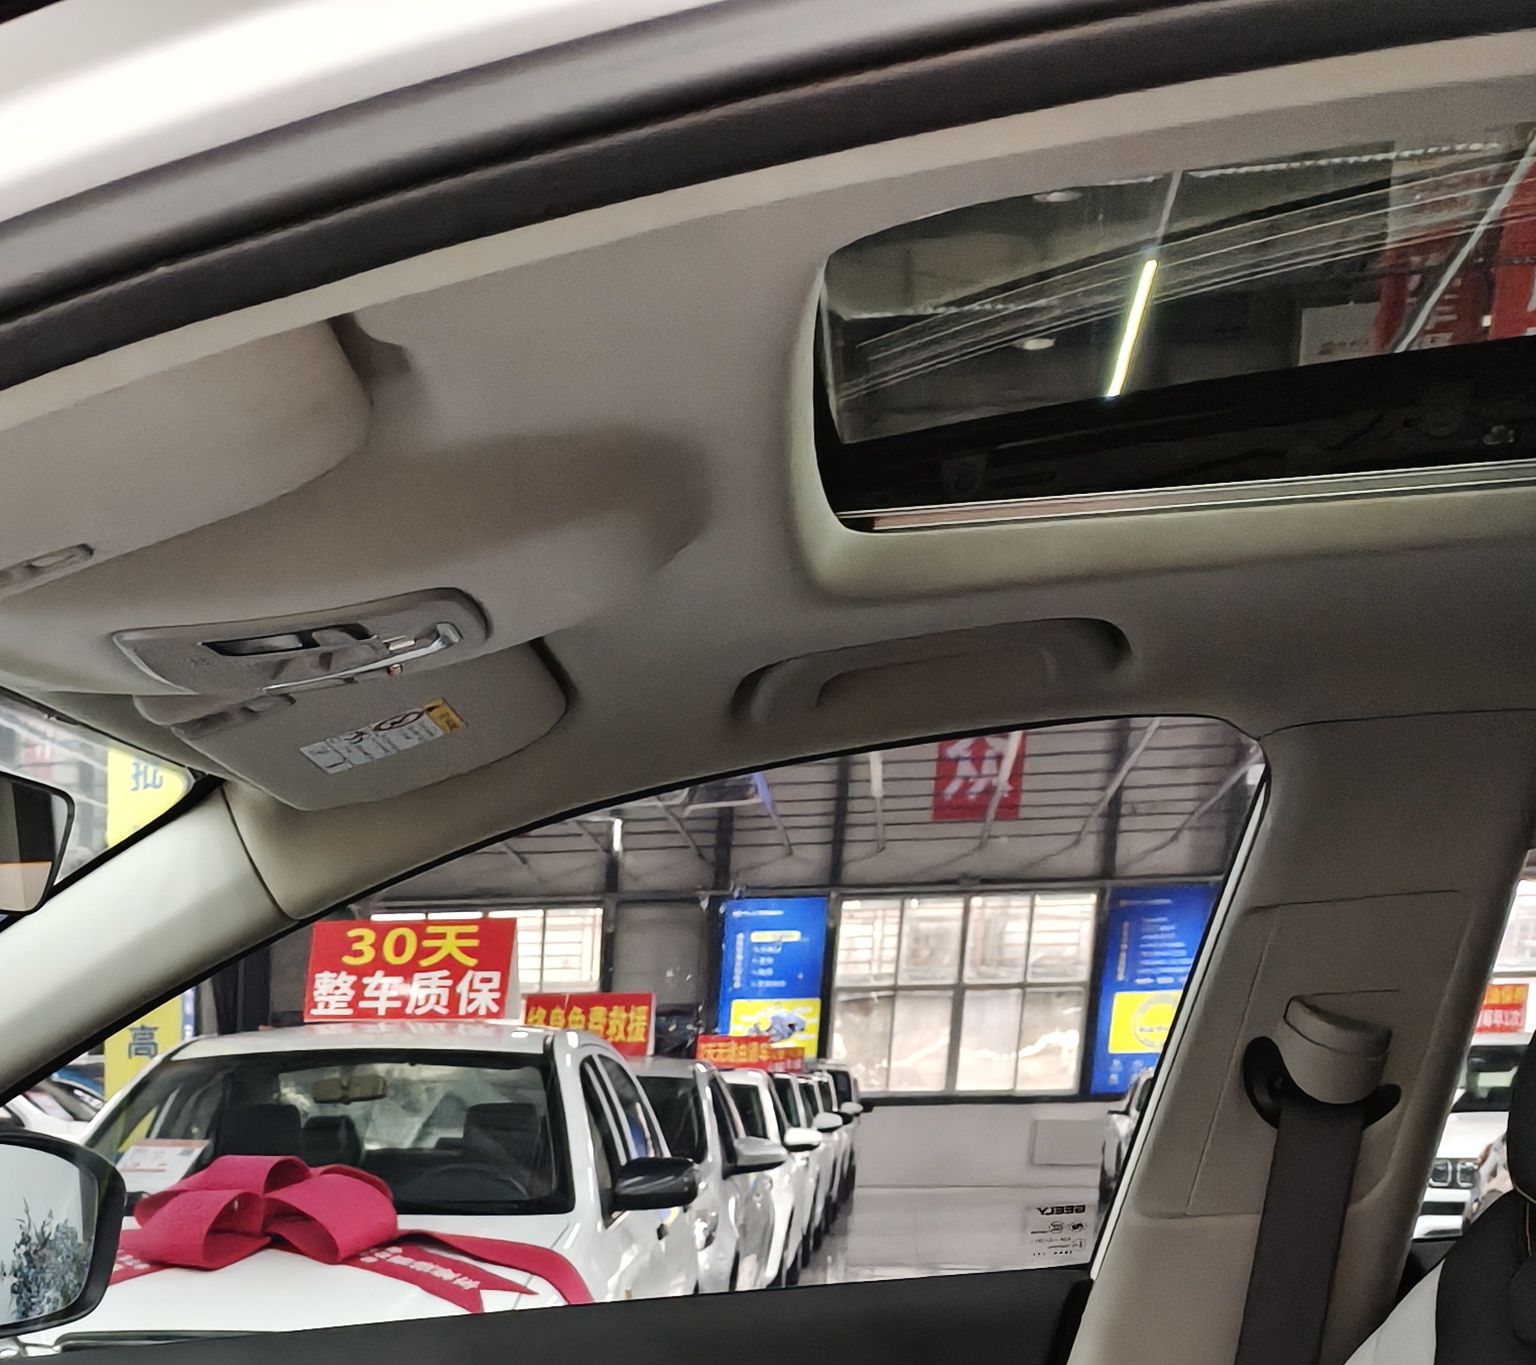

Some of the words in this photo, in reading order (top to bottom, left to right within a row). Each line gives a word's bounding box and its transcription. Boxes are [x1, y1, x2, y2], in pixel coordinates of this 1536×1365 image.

[341, 924, 481, 967] 30天
[310, 969, 502, 1016] 整车质保
[128, 1025, 159, 1060] 高
